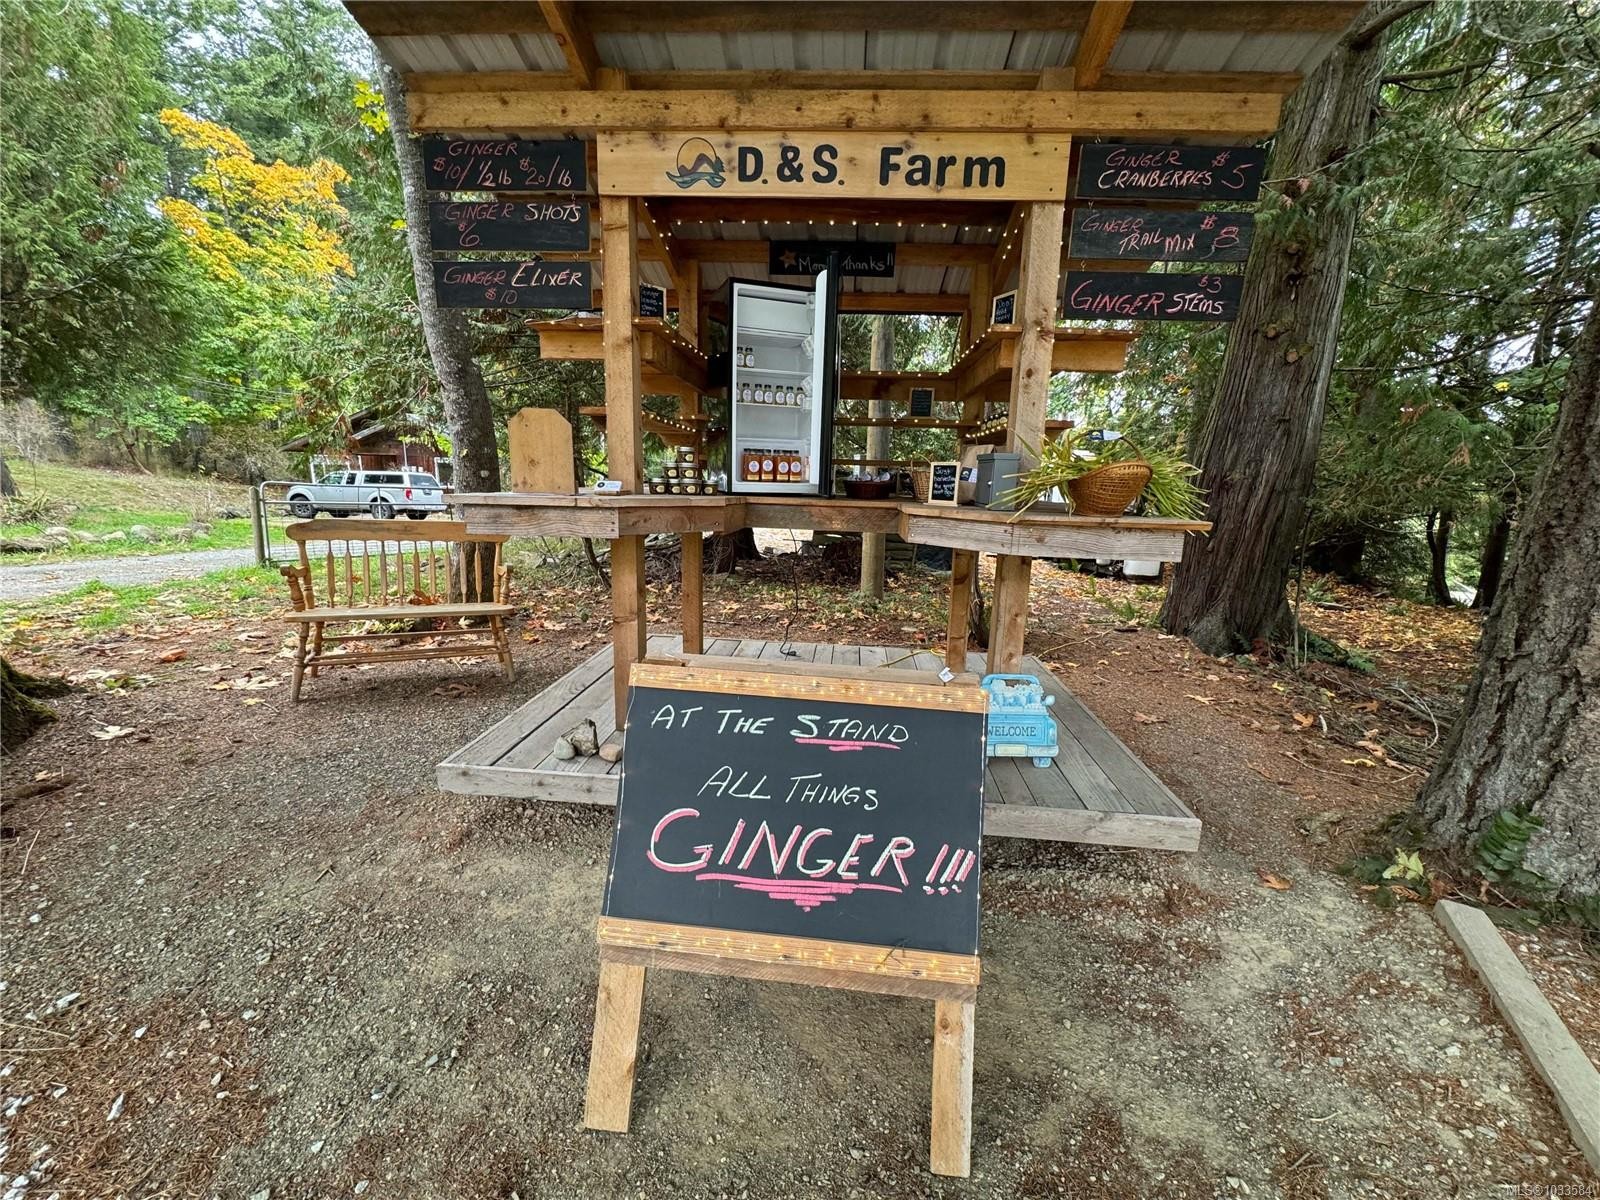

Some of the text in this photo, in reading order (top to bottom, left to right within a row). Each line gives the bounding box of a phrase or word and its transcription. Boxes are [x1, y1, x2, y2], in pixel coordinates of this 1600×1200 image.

[448, 141, 518, 157] GINGER
[1105, 148, 1183, 168] GINGER
[737, 143, 1006, 188] D.&S. Farm
[1098, 169, 1213, 189] CRANBERRIES
[444, 203, 582, 222] GINGER SHOTS
[1080, 214, 1144, 233] GINGER
[1118, 229, 1164, 255] TRAIL
[443, 261, 583, 287] GINGER ELIXER
[798, 255, 829, 273] Man
[1071, 280, 1165, 316] GINGER
[651, 704, 910, 743] AT THE STAND
[697, 765, 880, 811] ALL THINGS
[646, 807, 977, 896] GINGER !!!
